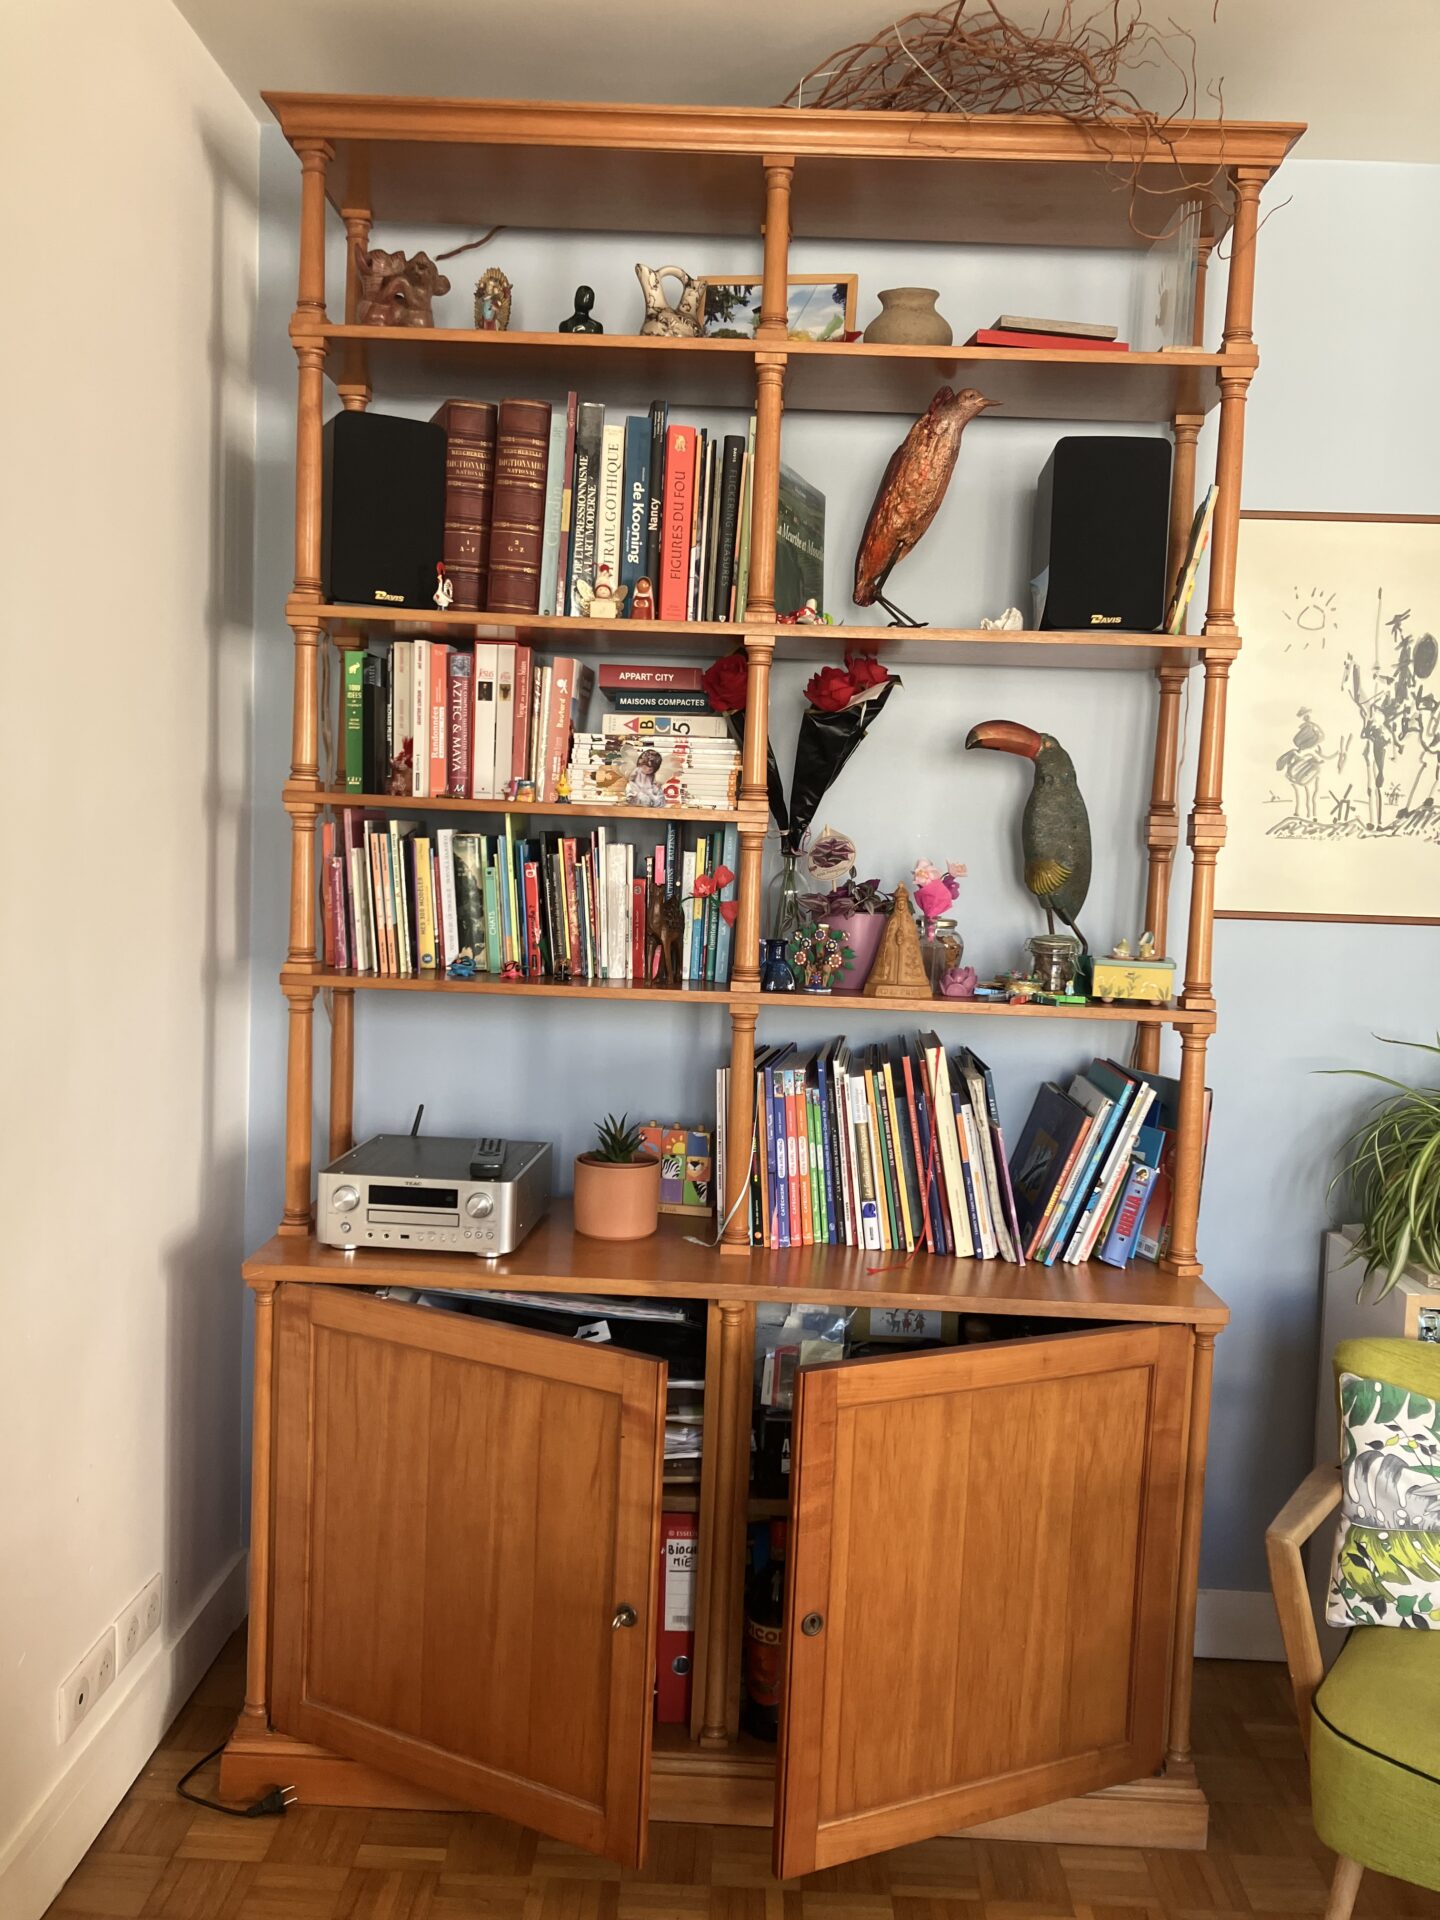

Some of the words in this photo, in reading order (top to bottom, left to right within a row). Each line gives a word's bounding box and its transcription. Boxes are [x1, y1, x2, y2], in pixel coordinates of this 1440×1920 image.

[605, 443, 621, 523] GOTHIQUE
[633, 481, 646, 501] de
[674, 471, 686, 498] FOU
[725, 468, 738, 528] FLICKERING
[545, 486, 562, 547] Chardin
[585, 484, 597, 537] MODERNE
[648, 497, 661, 531] Nancy
[673, 502, 685, 523] DU
[627, 502, 646, 565] Kooning
[670, 525, 684, 580] FIGURES
[721, 532, 733, 587] TREASURES
[374, 590, 405, 602] DAVIS
[1090, 614, 1122, 625] DAVIS
[655, 673, 674, 682] CITY
[452, 679, 462, 720] AZTEC
[556, 698, 566, 728] Routard
[619, 697, 656, 706] MAISONS
[657, 698, 705, 707] COMPACTES
[431, 706, 439, 759] Randonnées
[453, 723, 462, 734] &
[452, 736, 462, 772] MAYA
[489, 911, 497, 936] CHATS
[1115, 1195, 1143, 1238] BIBLIA
